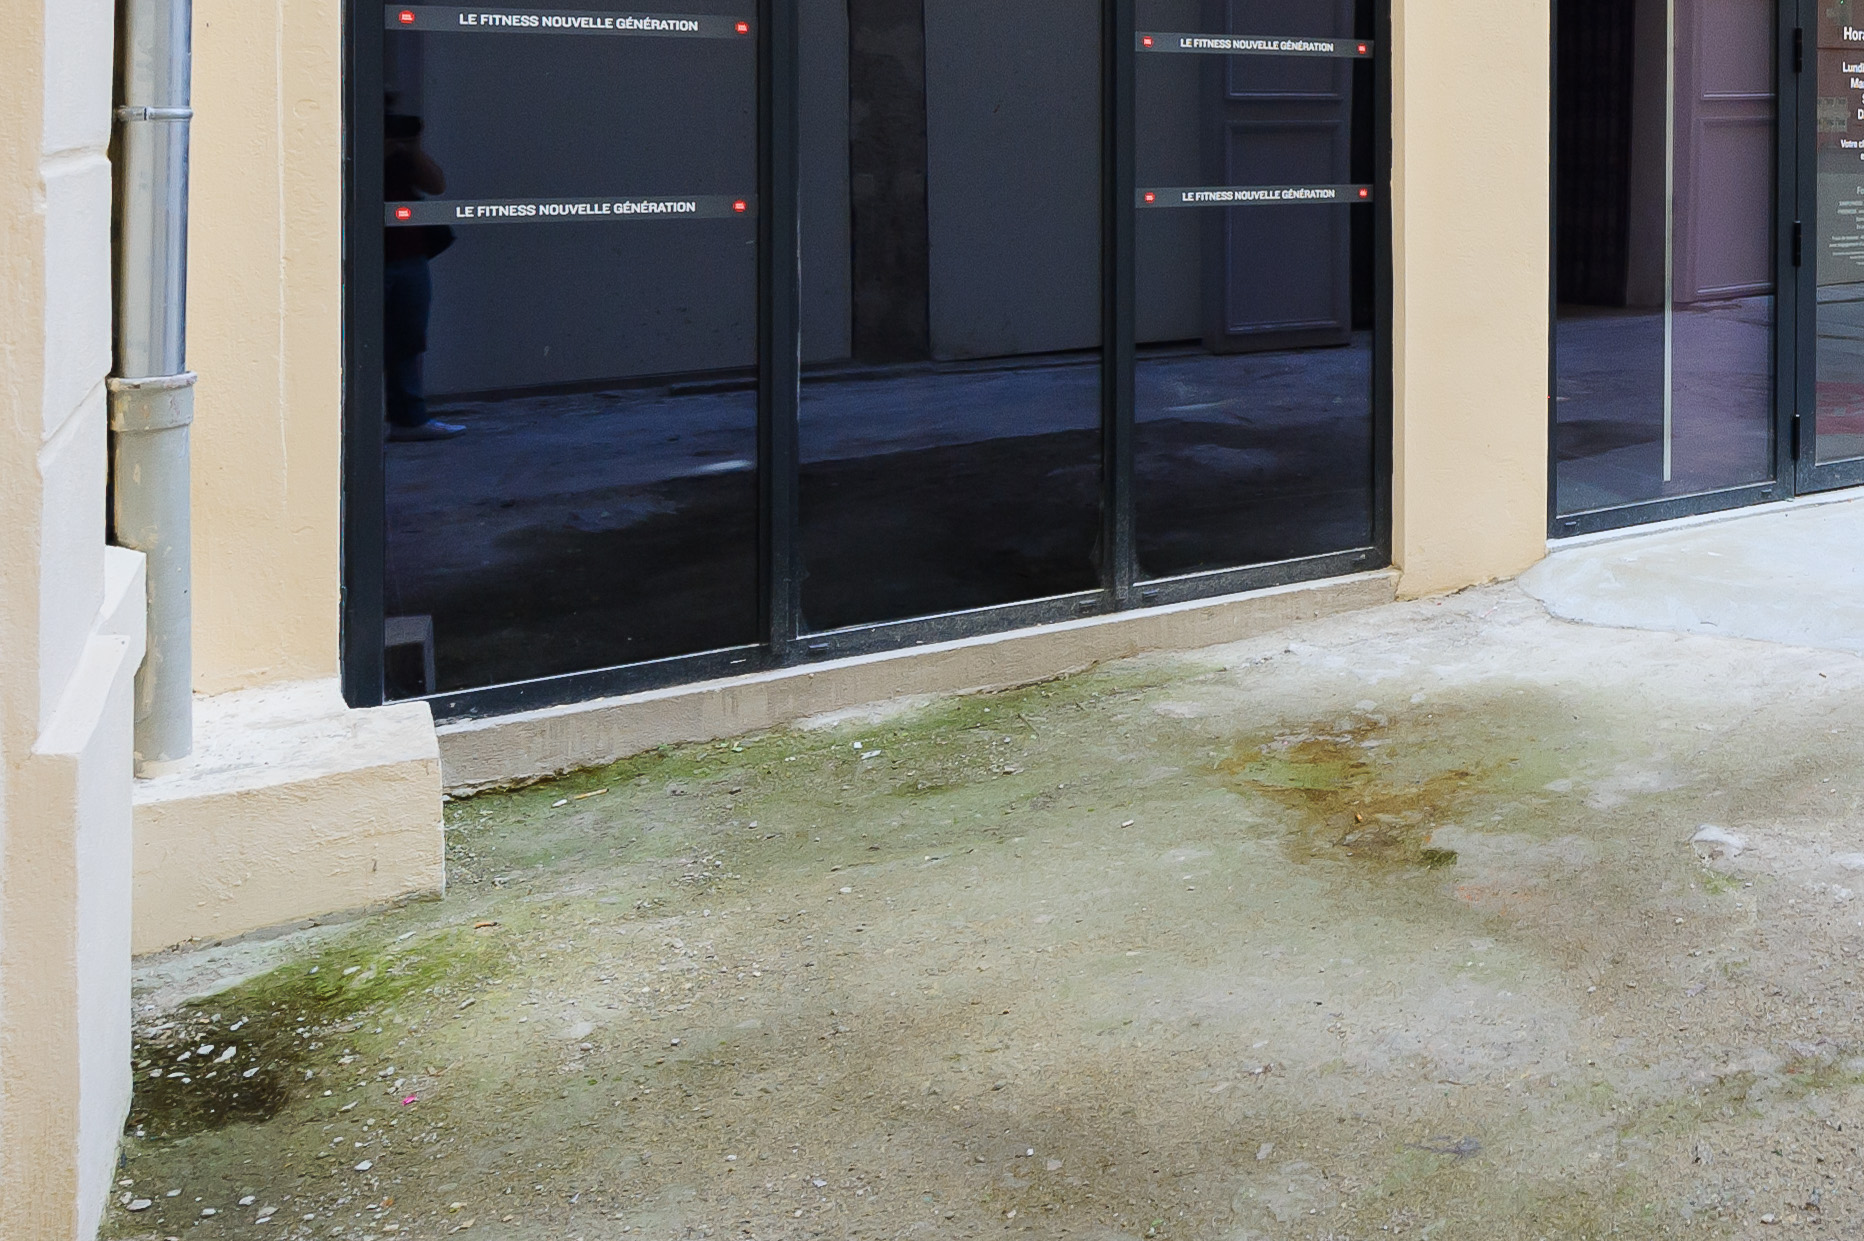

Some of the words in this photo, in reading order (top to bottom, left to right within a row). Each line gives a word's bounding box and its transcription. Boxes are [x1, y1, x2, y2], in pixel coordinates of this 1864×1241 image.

[459, 13, 477, 26] LE
[480, 14, 539, 27] FITNESS
[541, 15, 613, 29] NOUVELLE
[616, 16, 698, 31] GÉNÉRATION
[1180, 38, 1192, 48] LE
[1194, 38, 1231, 49] FITNESS
[1233, 40, 1279, 50] NOUVELLE
[1280, 39, 1334, 52] GÉNÉRATION
[1842, 62, 1864, 73] Lundi
[1182, 191, 1194, 201] LE
[1195, 191, 1233, 201] FITNESS
[1234, 189, 1280, 200] NOUVELLE
[1281, 188, 1335, 200] GÉNÉRATION
[456, 206, 474, 218] LE
[476, 205, 536, 217] FITNESS
[539, 203, 611, 216] NOUVELLE
[613, 200, 696, 215] GÉNÉRATION
